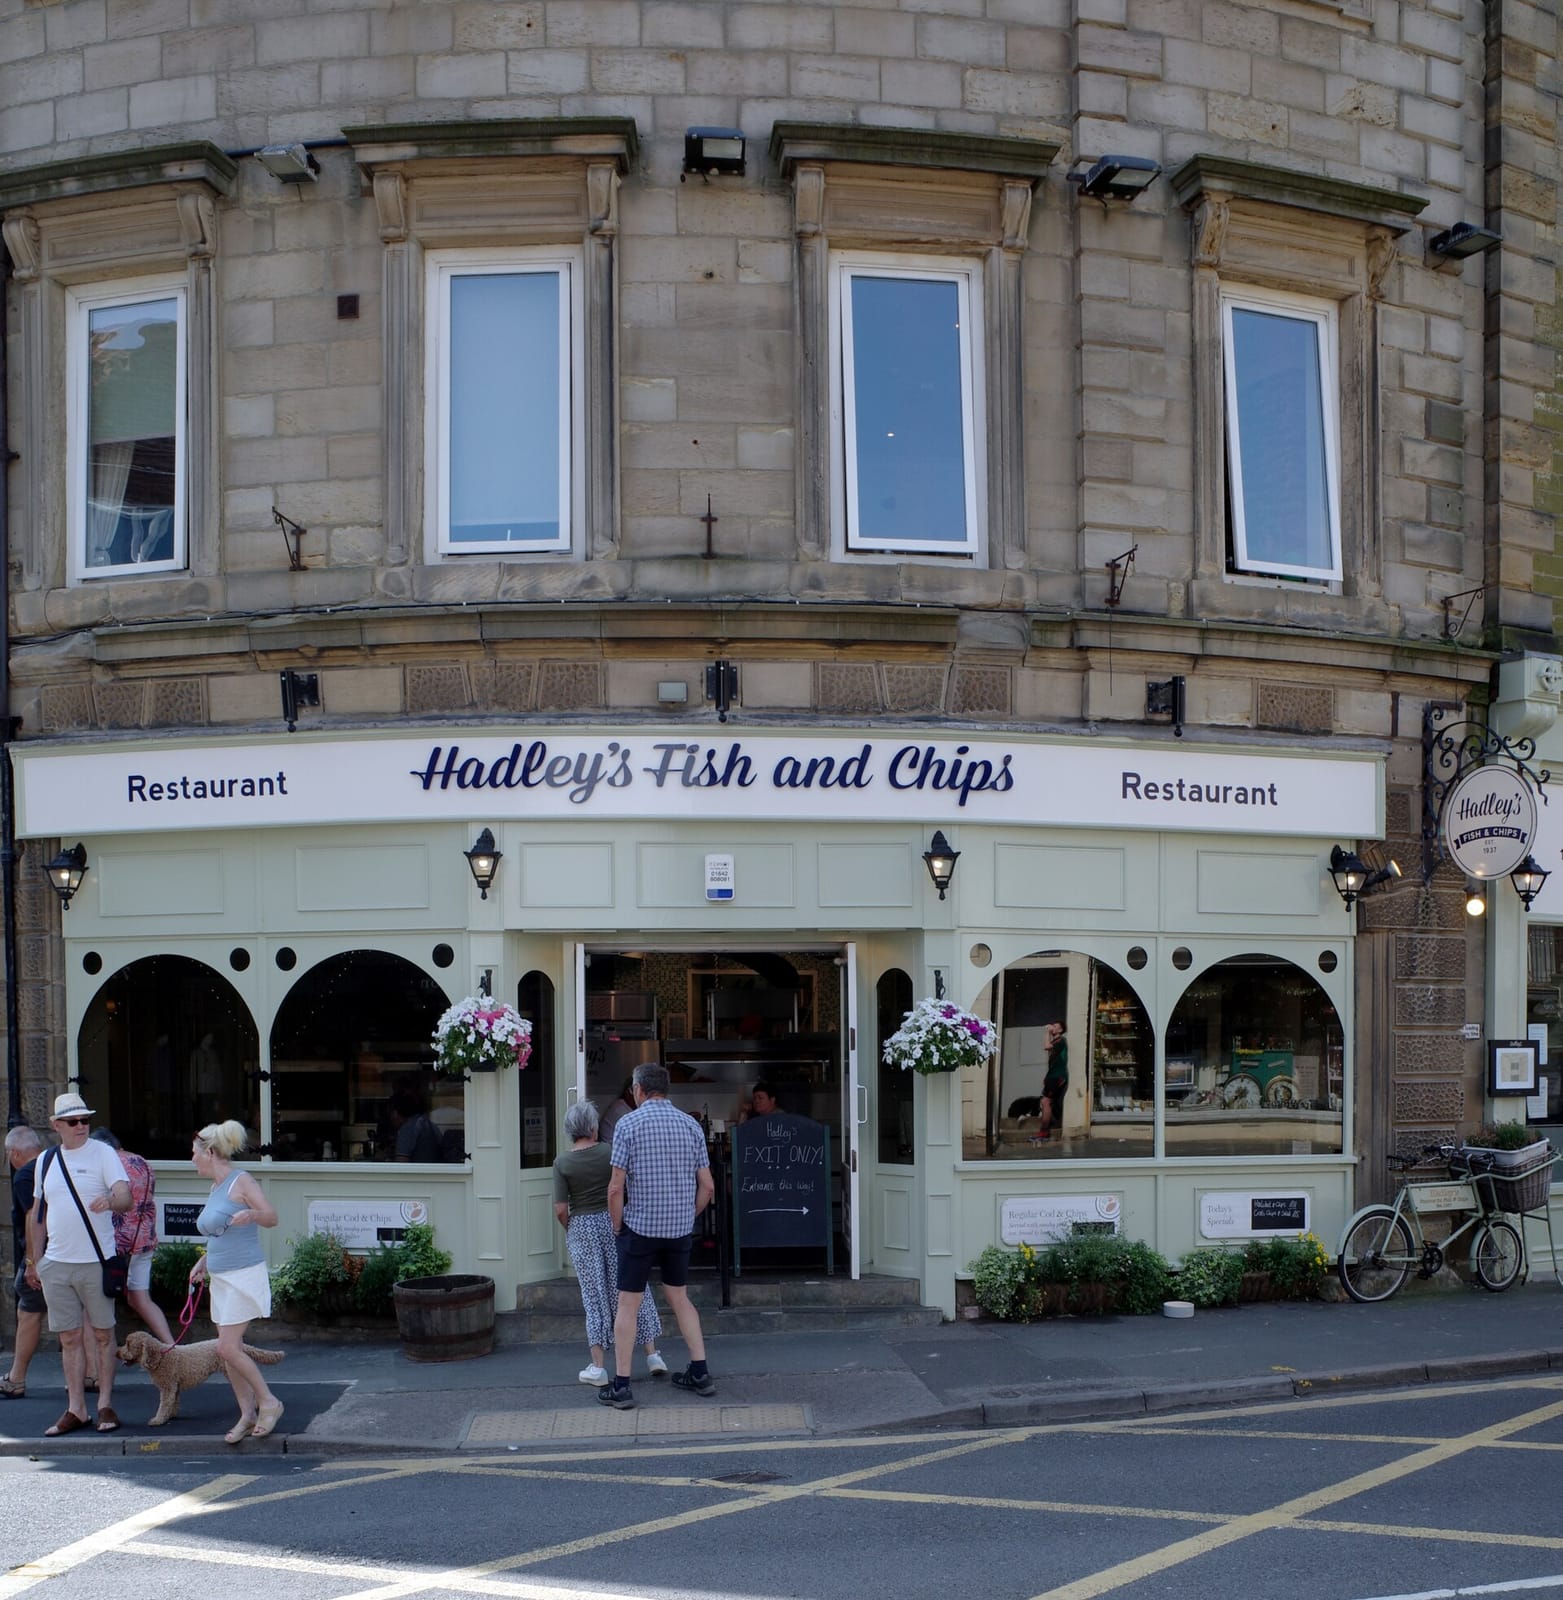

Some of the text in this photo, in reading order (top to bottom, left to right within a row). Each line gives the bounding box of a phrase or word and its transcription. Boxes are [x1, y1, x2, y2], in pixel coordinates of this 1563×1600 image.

[409, 741, 1014, 807] Hadley's Fish and Chips
[128, 771, 288, 802] Restaurant
[1122, 772, 1278, 806] Restaurant
[1456, 792, 1522, 824] Hadley's
[1463, 828, 1518, 842] FISH & CHIPS
[744, 1145, 824, 1165] EXIT ONLY!
[742, 1177, 775, 1192] Entrance
[779, 1179, 793, 1190] this
[1009, 1210, 1038, 1220] Regular
[1040, 1209, 1056, 1218] Cod
[1066, 1208, 1088, 1220] Chips
[1208, 1203, 1232, 1214] Today's
[314, 1213, 342, 1223] Regular
[344, 1213, 360, 1222] Cod
[370, 1213, 392, 1224] Chips
[1207, 1216, 1234, 1228] Specials
